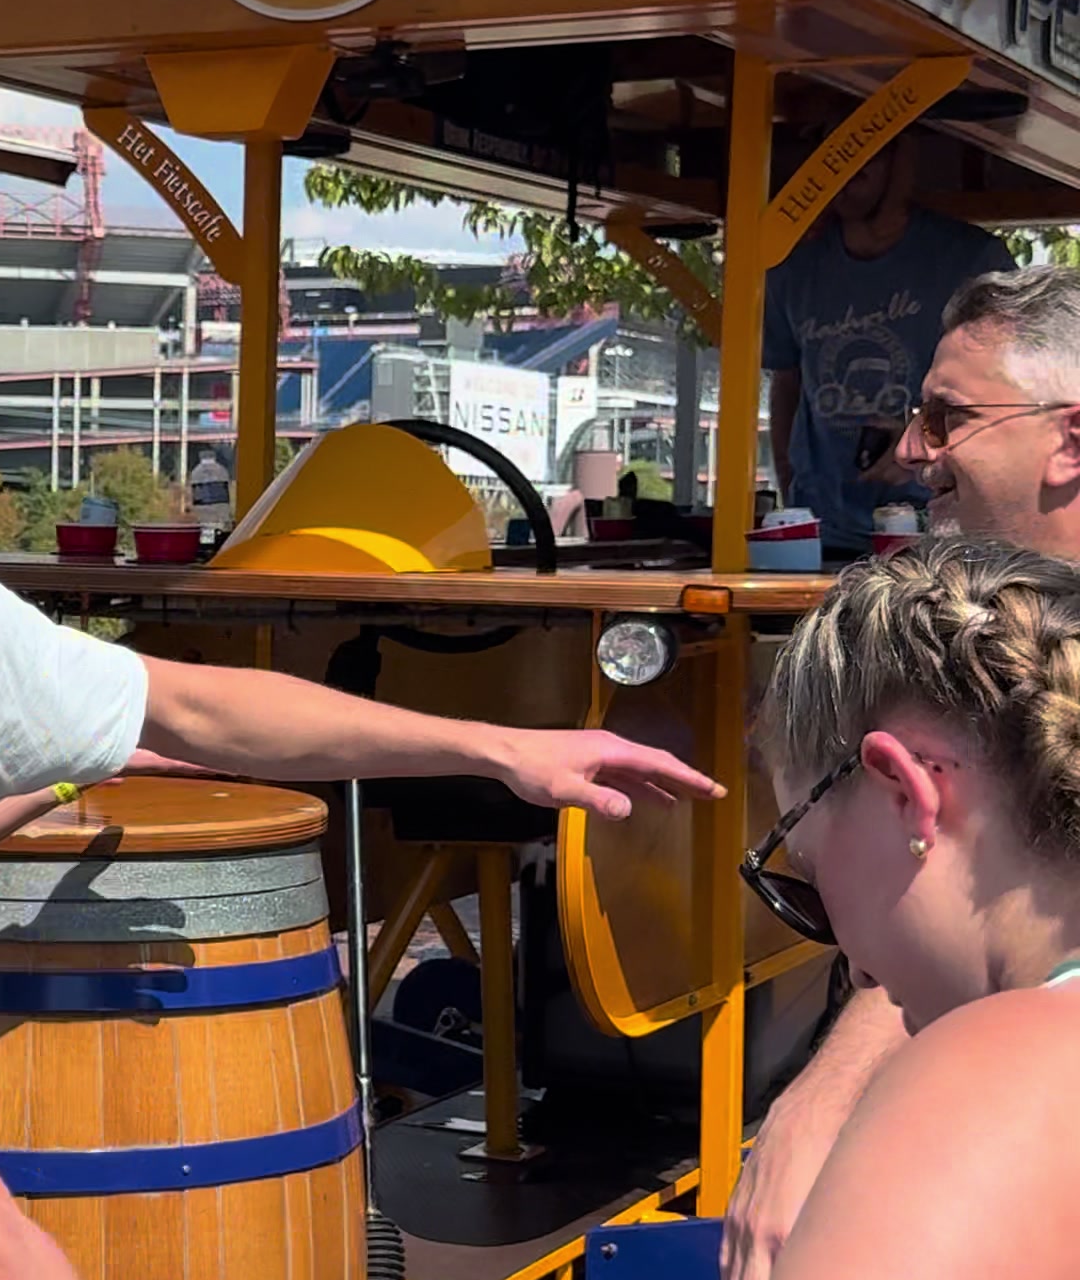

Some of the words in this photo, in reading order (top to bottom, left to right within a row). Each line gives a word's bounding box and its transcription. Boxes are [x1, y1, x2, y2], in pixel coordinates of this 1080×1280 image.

[116, 124, 156, 167] Het
[153, 158, 224, 243] Fietscafe
[777, 177, 825, 223] Het
[453, 401, 545, 437] NISSAN
